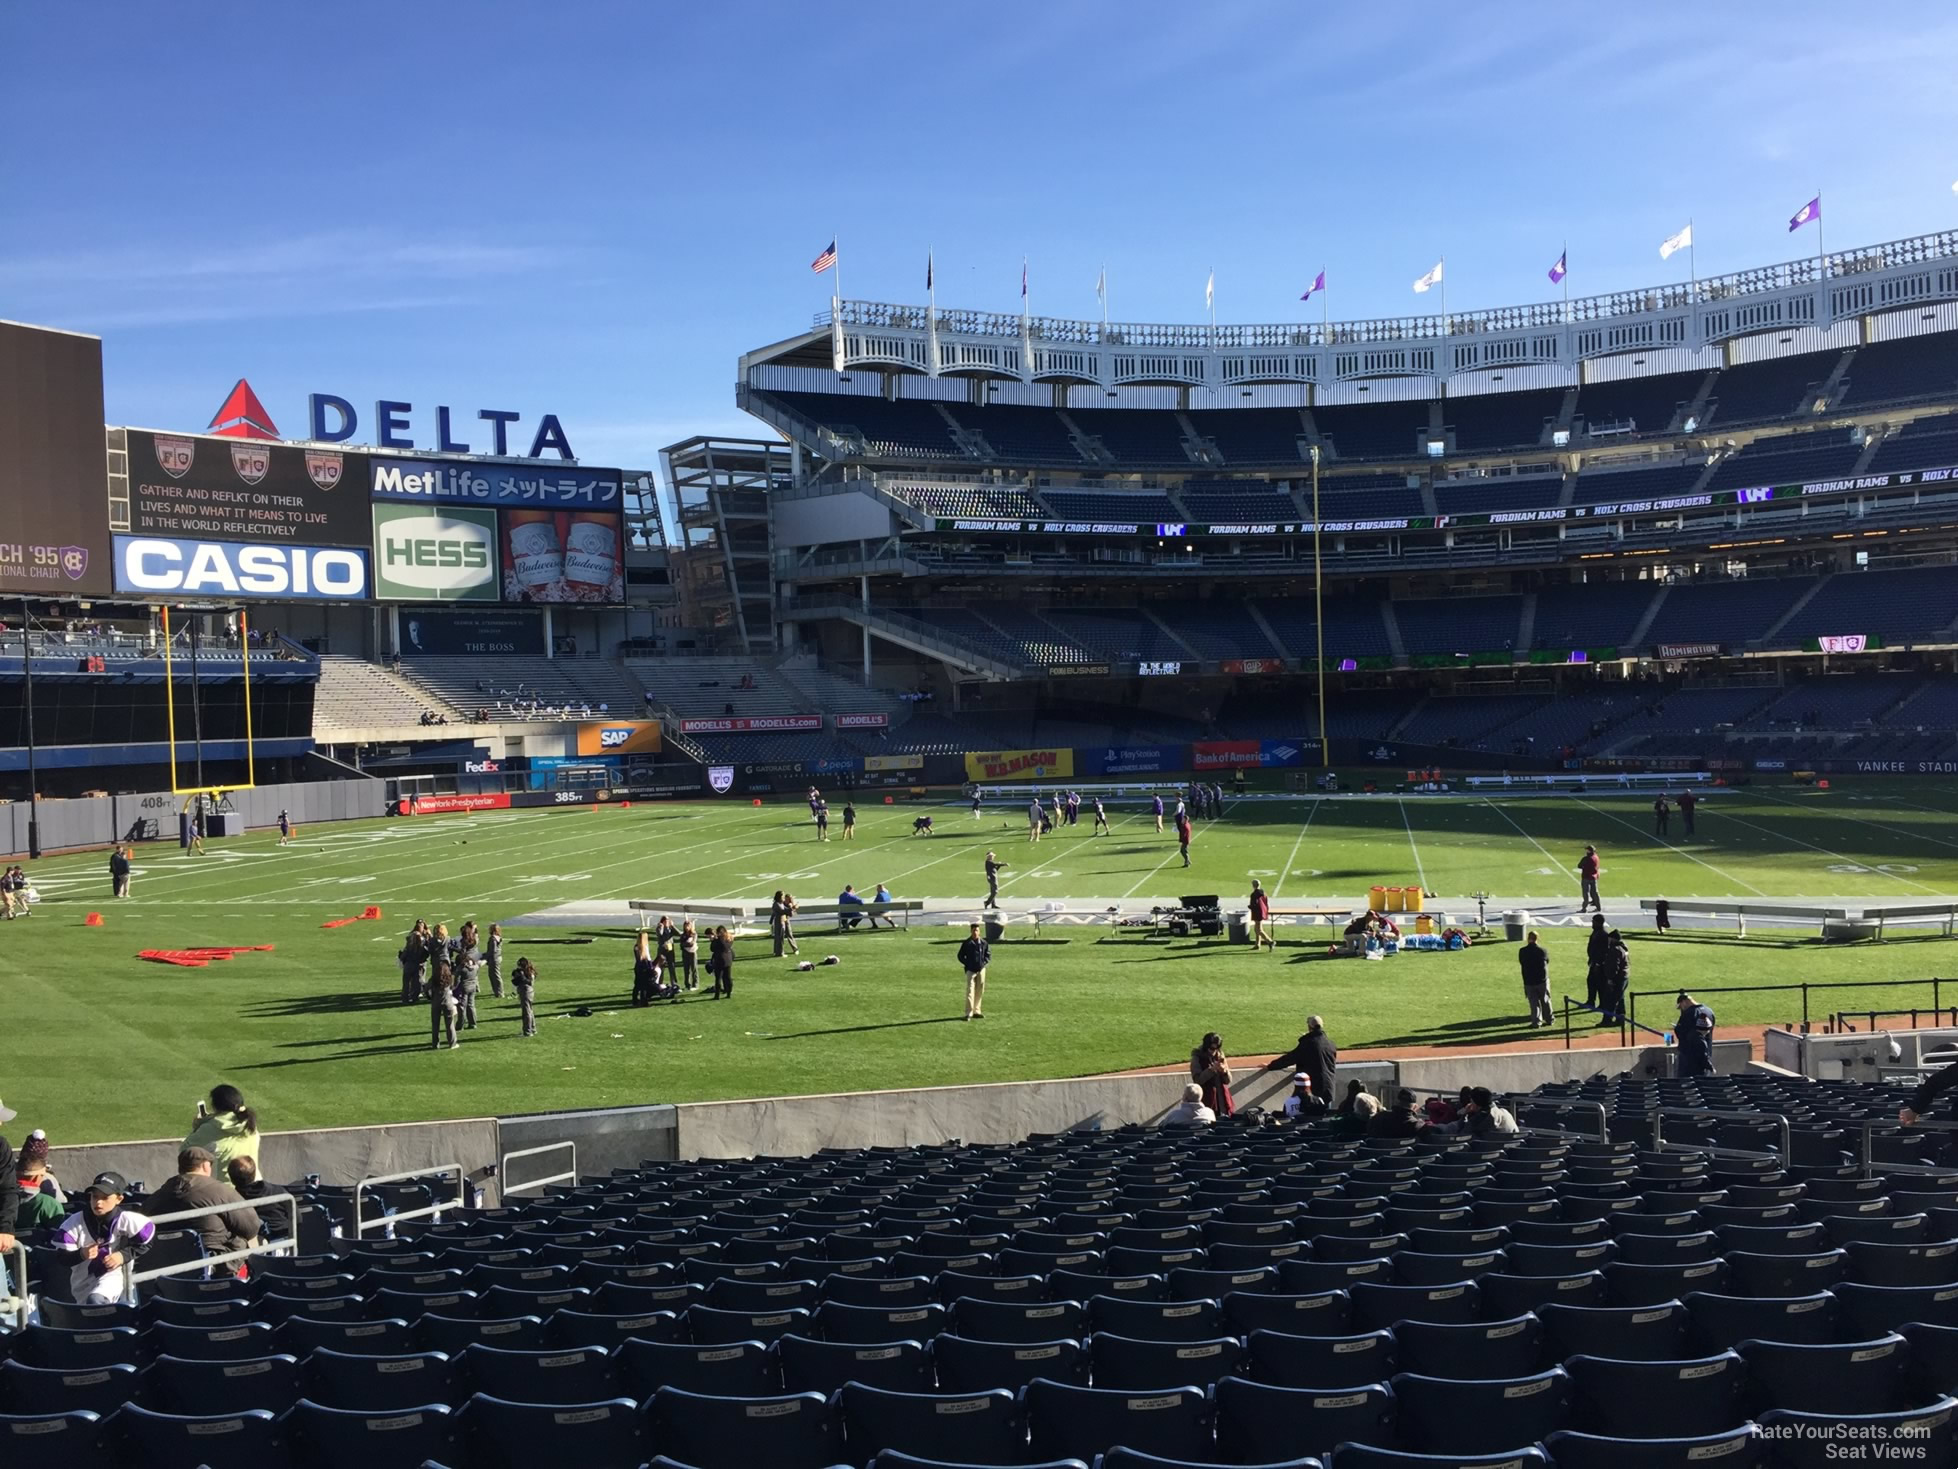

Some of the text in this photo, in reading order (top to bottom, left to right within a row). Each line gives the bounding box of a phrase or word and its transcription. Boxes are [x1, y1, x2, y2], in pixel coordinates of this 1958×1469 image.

[309, 393, 575, 459] DELTA
[374, 466, 490, 497] MetLife
[1802, 481, 1854, 495] FORDHAM
[1856, 477, 1890, 489] RAMS
[1921, 469, 1952, 482] HOLY
[139, 484, 184, 499] GATHER
[187, 488, 209, 500] AND
[253, 493, 269, 505] ON
[271, 495, 304, 508] THEIR
[498, 477, 617, 502] メットライフ
[140, 501, 328, 524] LIVES AND WHAT IT MEANS TO LIVE
[1490, 511, 1535, 523] FORDHAM
[1537, 509, 1567, 521] RAMS
[1593, 504, 1618, 516] HOLY
[1619, 502, 1652, 513] CROSS
[1653, 495, 1713, 510] CRUSADERS
[141, 516, 297, 536] IN THE WORLD REFLECTIVELY
[953, 520, 995, 531] FORDHAM
[997, 521, 1022, 531] RAMS
[1043, 523, 1064, 532] HOLY
[1065, 523, 1090, 533] CROSS
[1091, 523, 1138, 534] CRUSADERS
[1208, 524, 1249, 535] FORDHAM
[1250, 523, 1277, 533] RAMS
[1324, 520, 1353, 532] CROSS
[1354, 519, 1408, 531] CRUSADERS
[0, 543, 23, 564] CH
[386, 538, 487, 568] HESS
[30, 567, 60, 579] CHAIR
[125, 539, 365, 595] CASIO
[465, 643, 515, 652] THE BOSS
[1067, 666, 1109, 675] BUSINESS
[685, 720, 732, 731] MODELL'S
[750, 718, 818, 729] MODELLS.com
[842, 715, 884, 725] MODELL'S
[601, 731, 629, 746] SAP
[1120, 750, 1160, 761] PlayStation
[1195, 753, 1218, 764] Bank
[1230, 751, 1271, 763] America
[466, 760, 500, 773] FedEx
[756, 764, 793, 773] GATORADE
[829, 761, 854, 773] pepsi
[1857, 761, 1905, 773] YANKEE
[366, 907, 377, 916] 20
